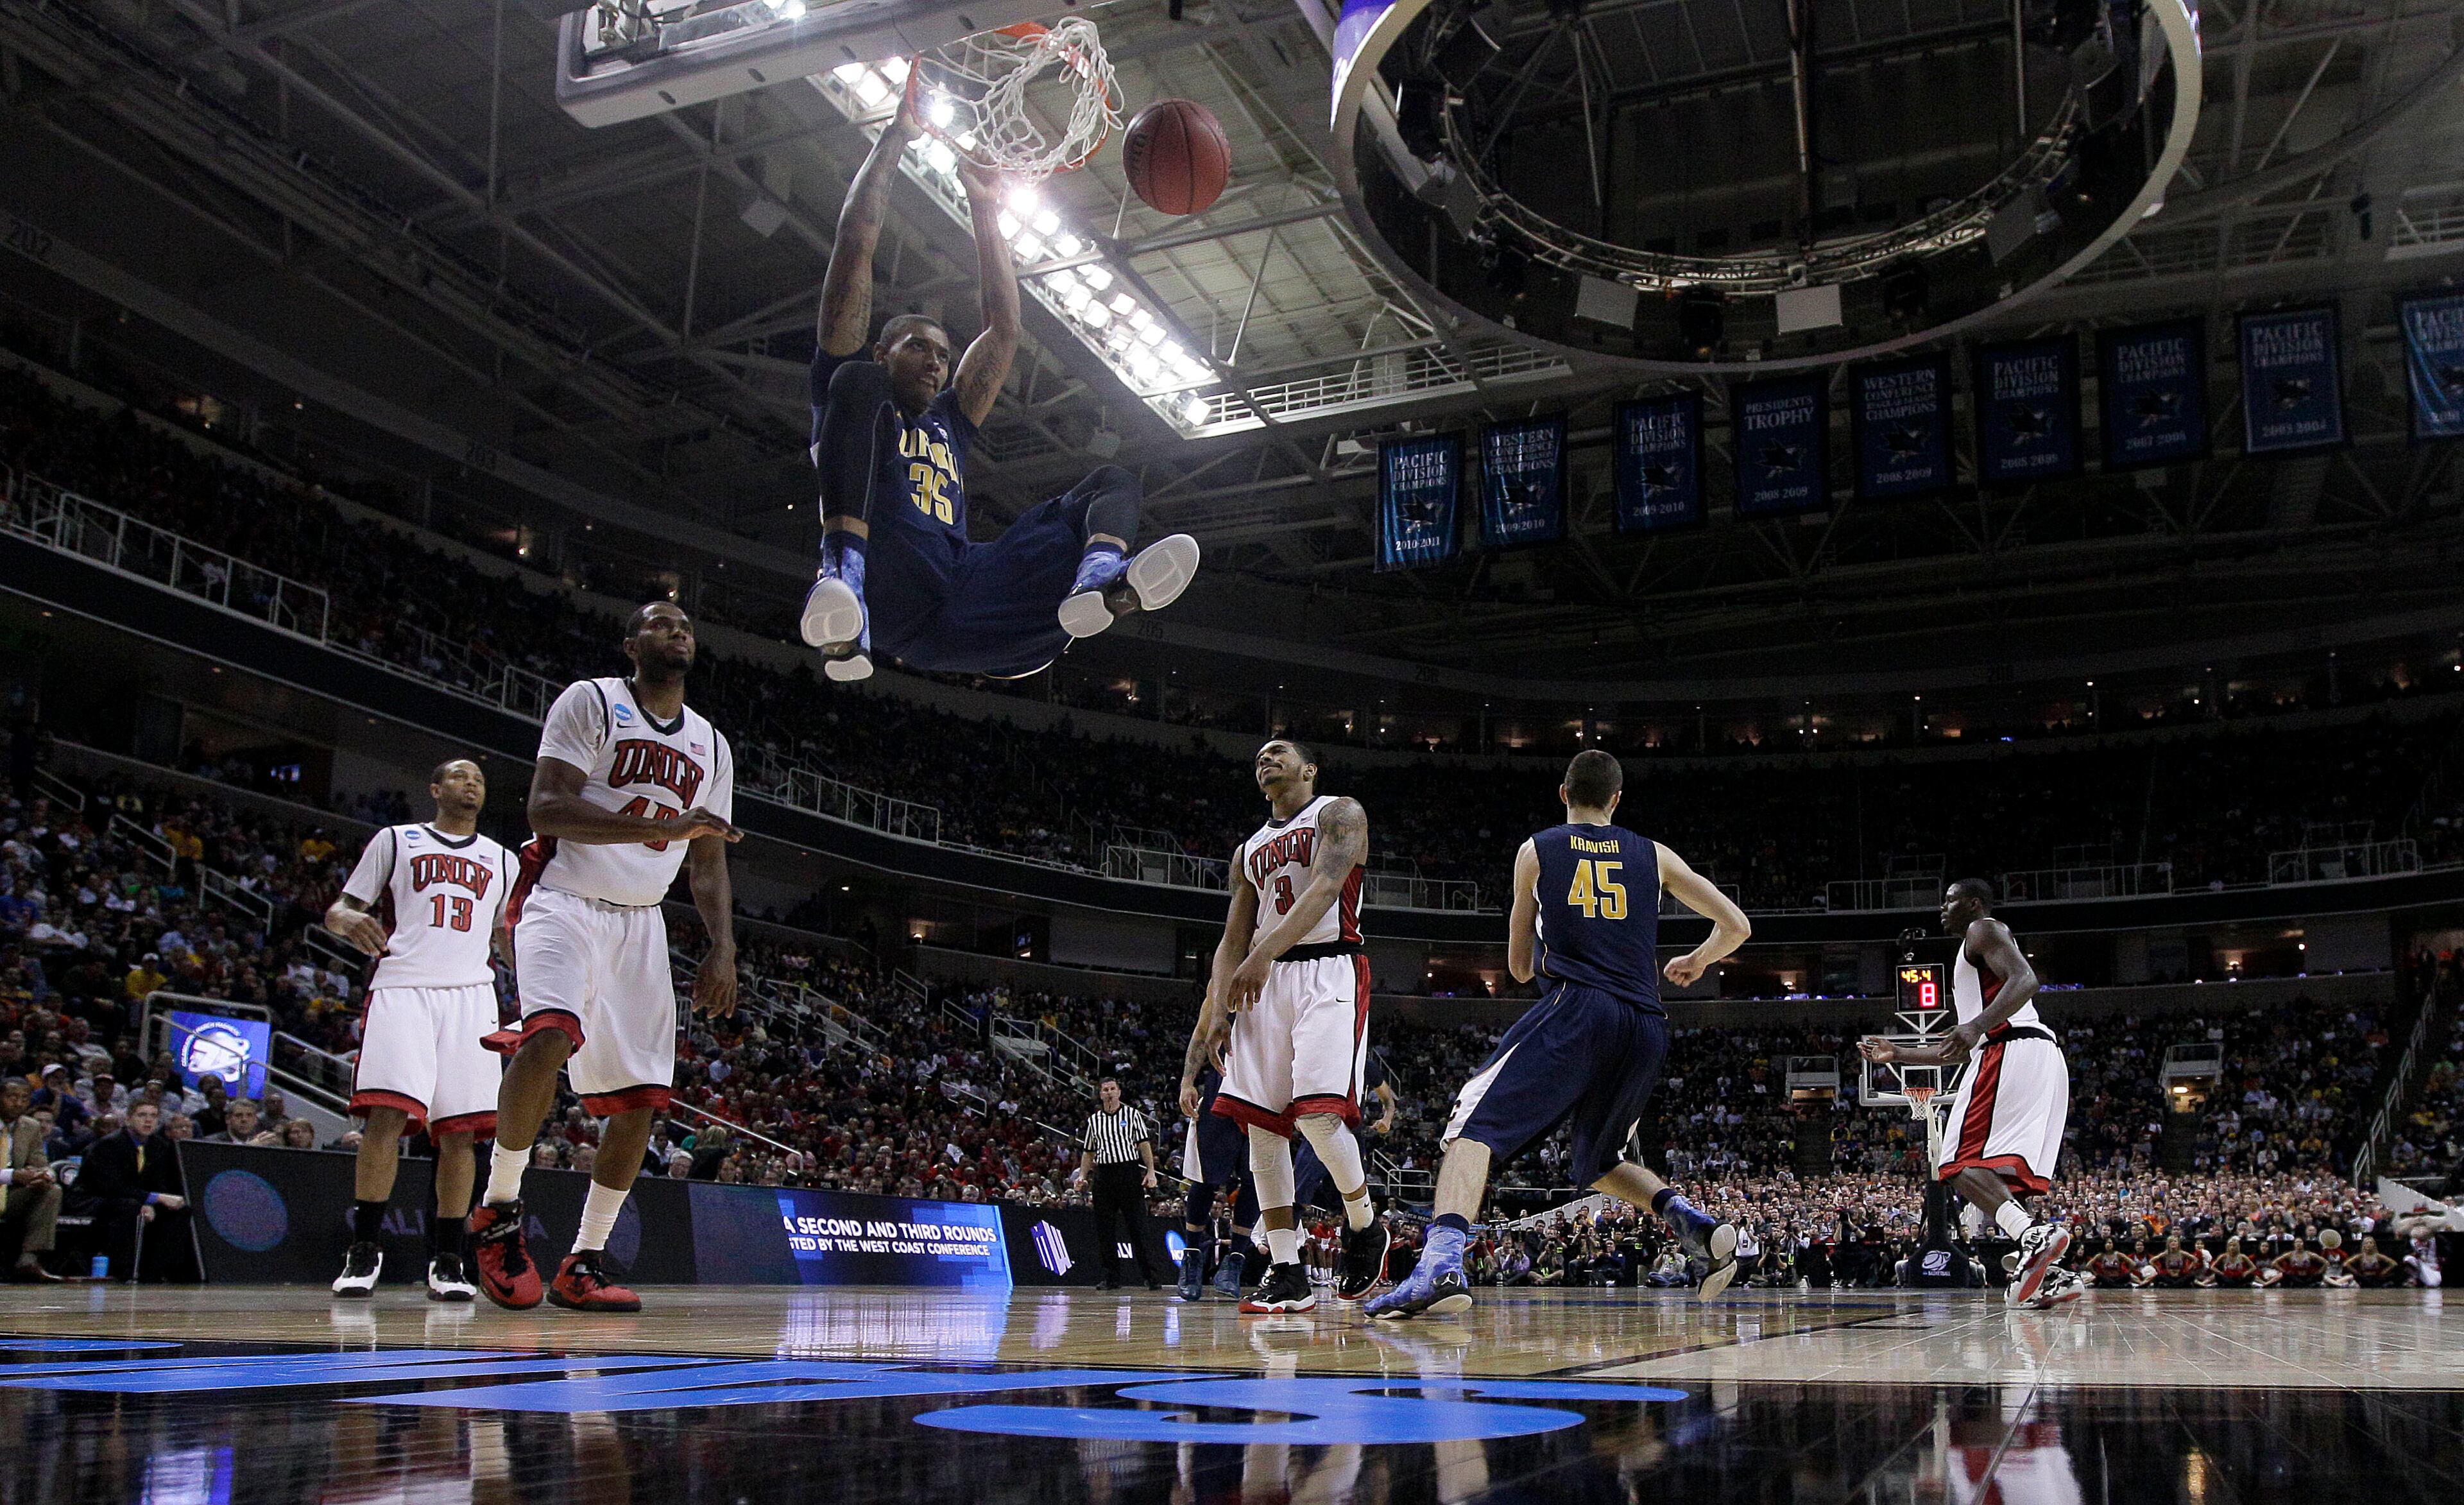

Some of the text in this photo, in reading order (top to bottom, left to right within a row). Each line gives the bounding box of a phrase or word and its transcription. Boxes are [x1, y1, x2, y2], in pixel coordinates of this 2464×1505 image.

[2252, 322, 2323, 343] PACIFIC
[2118, 338, 2184, 360] PACIFIC
[1994, 355, 2058, 377] PACIFIC
[1864, 368, 1935, 389] WESTERN
[1994, 370, 2058, 390] DIVISION
[1631, 411, 1685, 432] PACIFIC
[1744, 406, 1814, 431] TROPHY
[1866, 402, 1937, 421] CHAMPIONS
[1490, 427, 1554, 446] WESTERN
[1631, 426, 1686, 445] DIVISION
[1630, 439, 1686, 454] CHAMPIONS
[1394, 450, 1448, 470] PACIFIC
[1490, 458, 1554, 475] CHAMPIONS
[1394, 464, 1448, 482] DIVISION
[909, 462, 954, 525] 35
[1393, 476, 1448, 491] CHAMPIONS
[1396, 536, 1441, 551] 2010-2011
[1137, 620, 1163, 639] 205
[608, 739, 705, 810] UNLV
[1570, 834, 1620, 854] KRAVISH
[1249, 827, 1316, 890] UNLV
[409, 853, 493, 900] UNLV
[1274, 875, 1296, 915] 3
[1568, 859, 1628, 920] 45
[427, 893, 473, 932] 13
[1901, 969, 1931, 983] 45.4
[1921, 983, 1937, 1007] 8
[797, 1217, 862, 1237] SECOND
[867, 1221, 898, 1238] AND
[898, 1223, 941, 1241] THIRD
[942, 1225, 997, 1243] ROUNDS
[817, 1238, 833, 1251] BY
[835, 1239, 859, 1252] THE
[859, 1240, 890, 1253] WEST
[892, 1241, 925, 1254] COAST
[927, 1243, 991, 1256] CONFERENCE
[1117, 1242, 1133, 1259] LV
